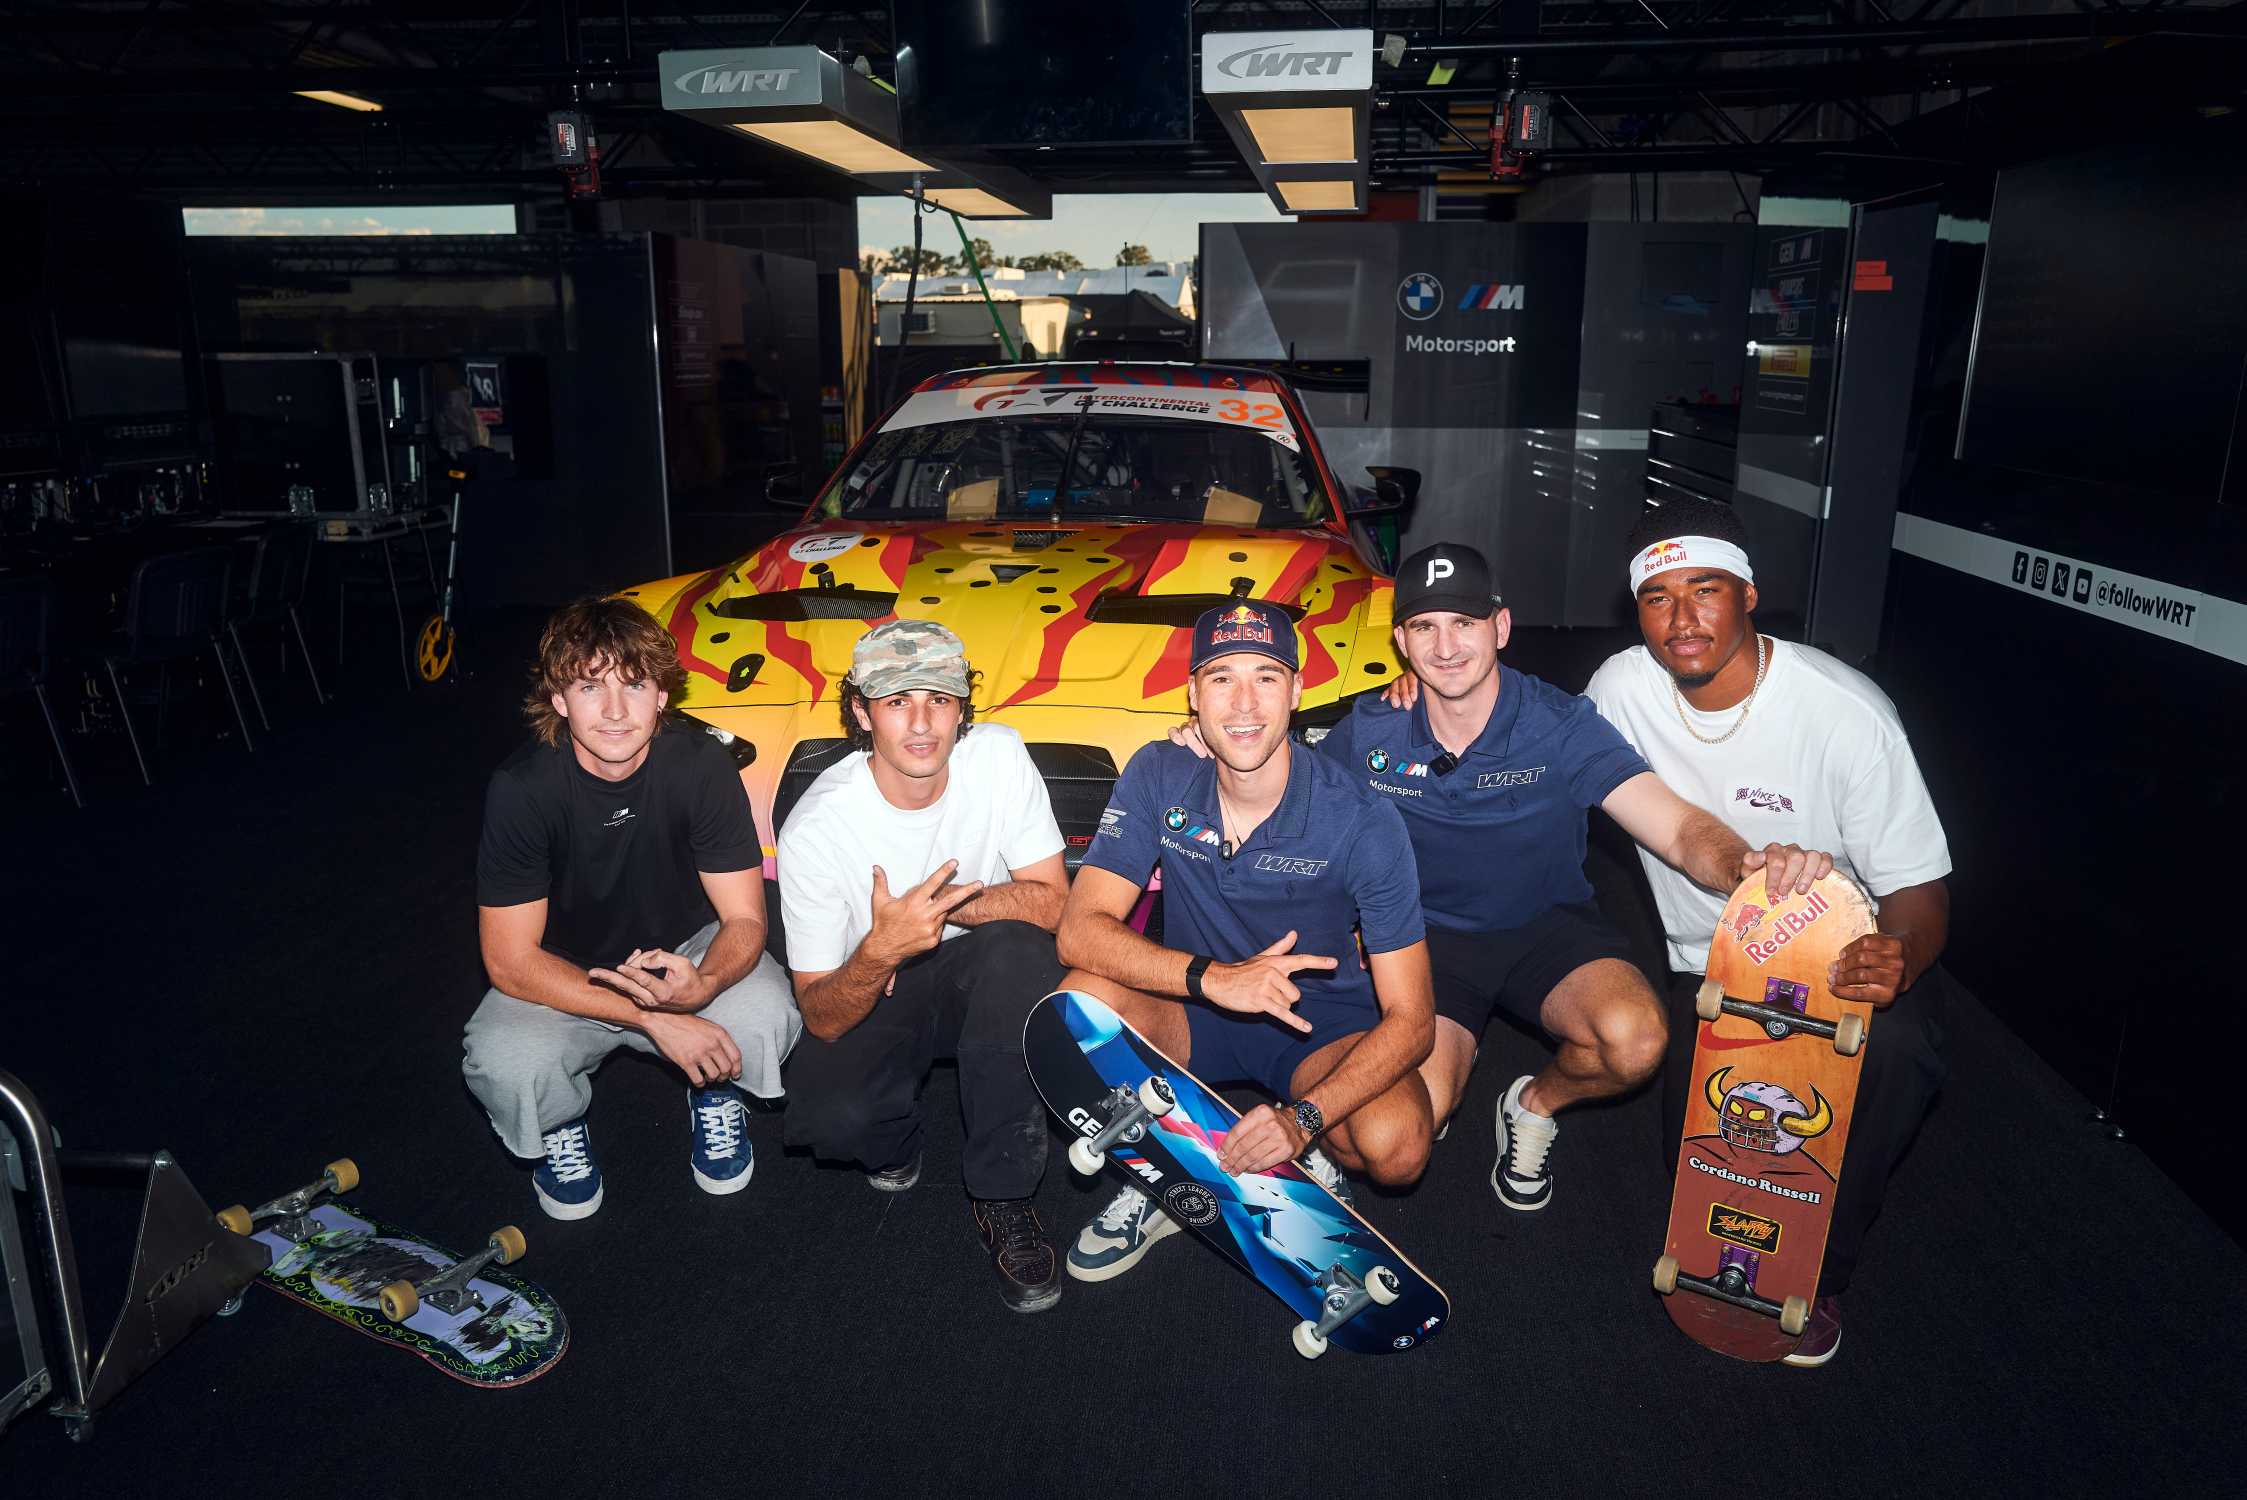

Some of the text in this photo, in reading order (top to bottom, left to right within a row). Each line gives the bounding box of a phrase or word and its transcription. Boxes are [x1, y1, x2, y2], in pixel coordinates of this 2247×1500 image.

[1245, 51, 1353, 77] WRT
[701, 68, 800, 94] WRT
[1405, 335, 1516, 356] Motorsport
[1102, 400, 1210, 414] CHALLENGE
[1218, 398, 1284, 429] 32
[1644, 551, 1687, 574] Red Bull
[2095, 580, 2196, 627] @followWRT
[1212, 624, 1274, 646] Red Bull
[1369, 779, 1422, 798] Motorsport
[1477, 765, 1546, 789] WRT
[1748, 788, 1775, 801] NIKE
[1255, 854, 1328, 877] WRT
[1744, 890, 1830, 965] Red Bull
[1187, 1185, 1211, 1198] LEAGUE
[1688, 1156, 1822, 1204] Cordano Russell
